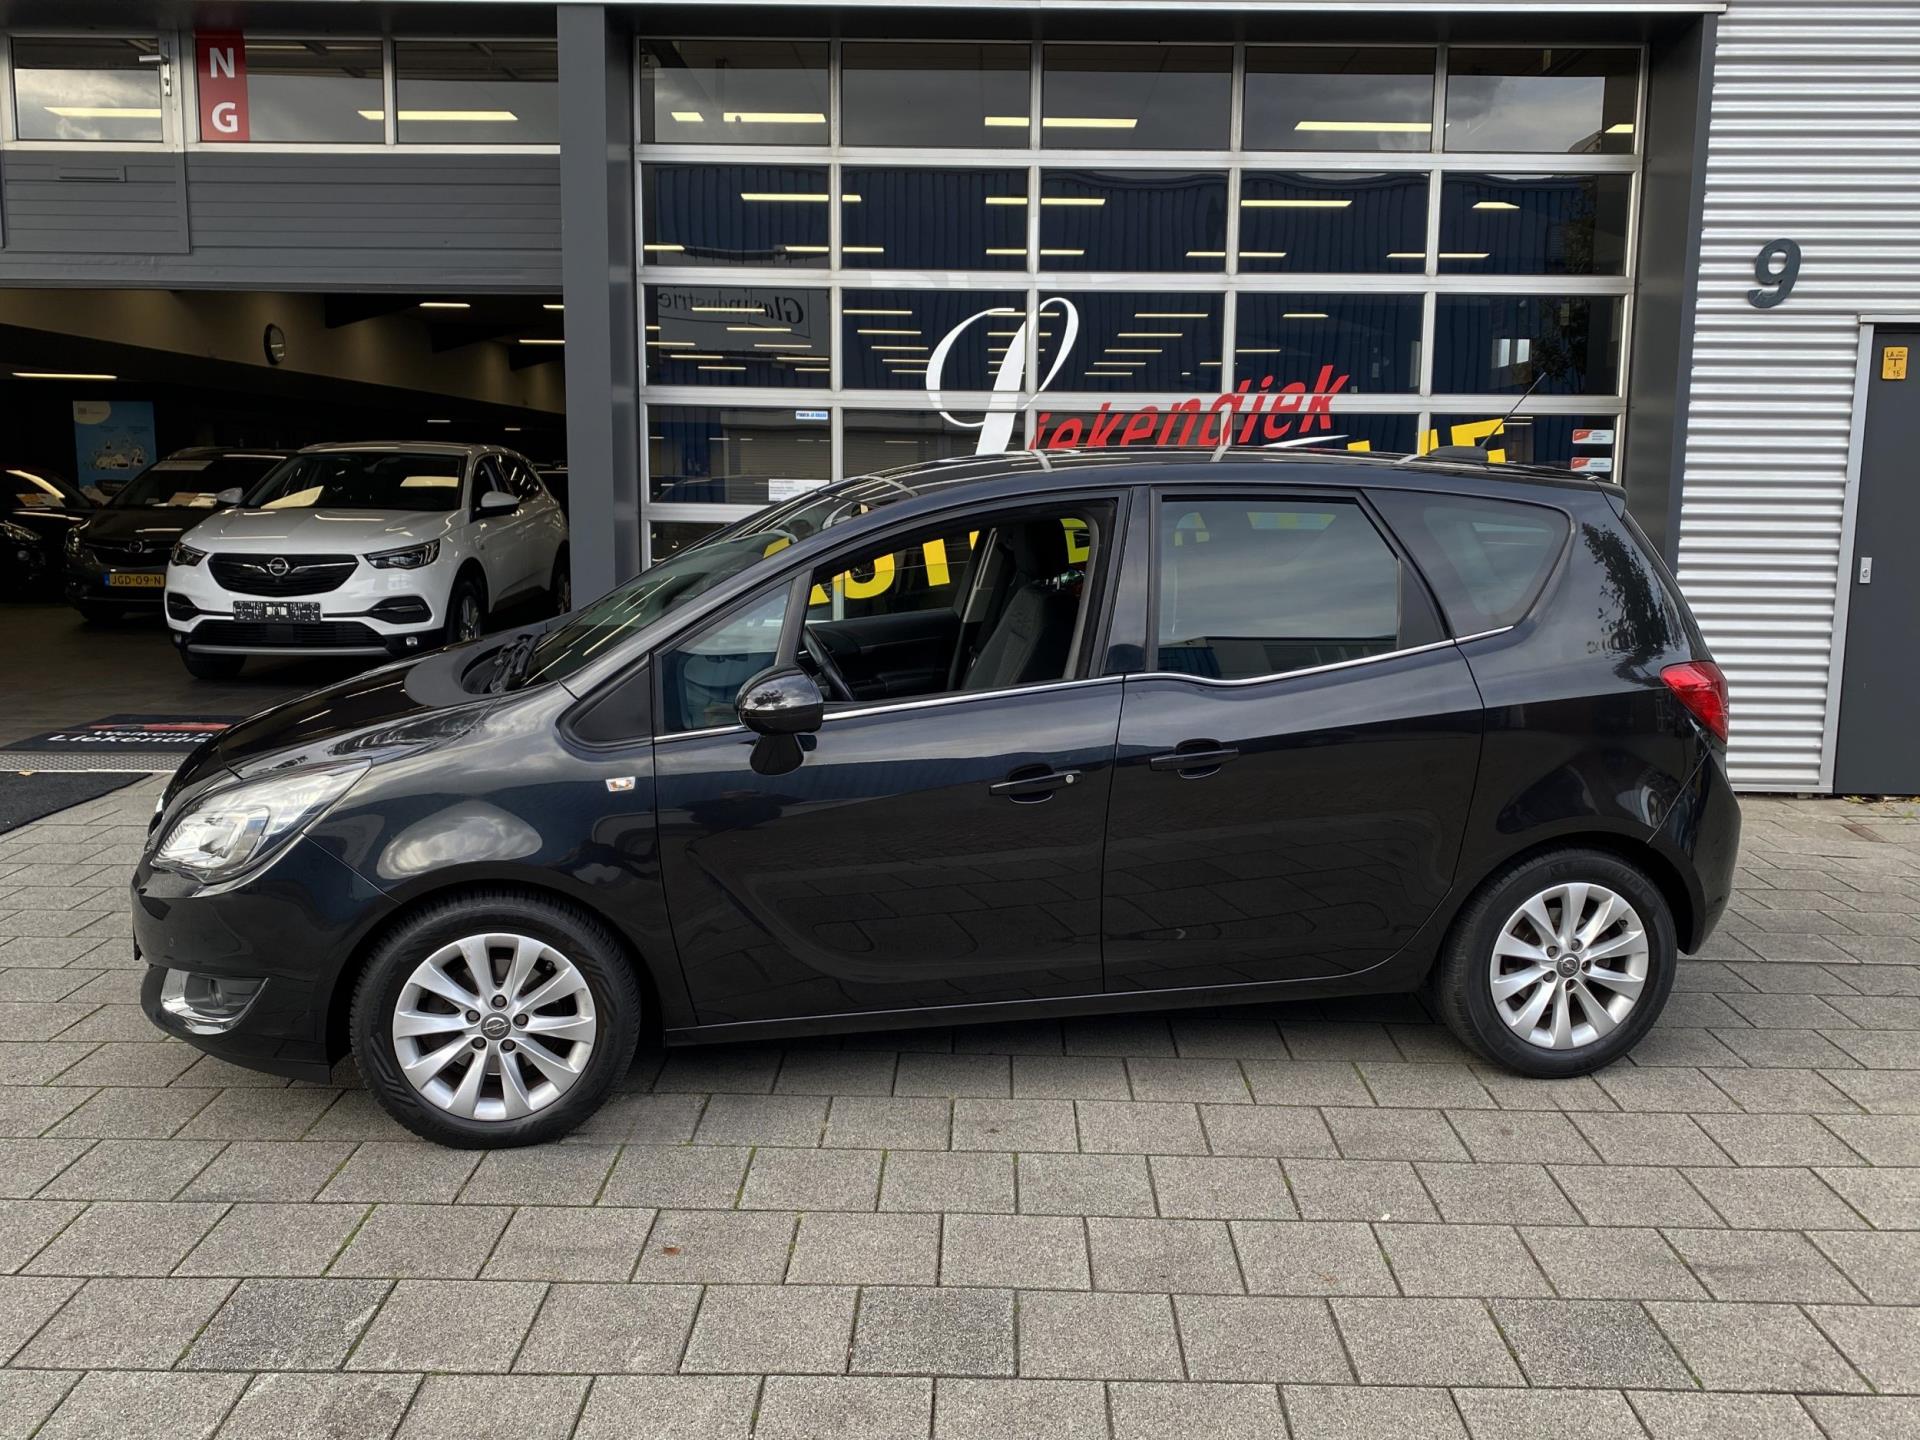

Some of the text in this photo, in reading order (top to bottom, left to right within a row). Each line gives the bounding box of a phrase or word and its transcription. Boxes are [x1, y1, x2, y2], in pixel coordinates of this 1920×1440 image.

[1747, 238, 1802, 308] 9
[112, 575, 161, 585] JGD-09-N
[47, 734, 209, 743] Liekendie
